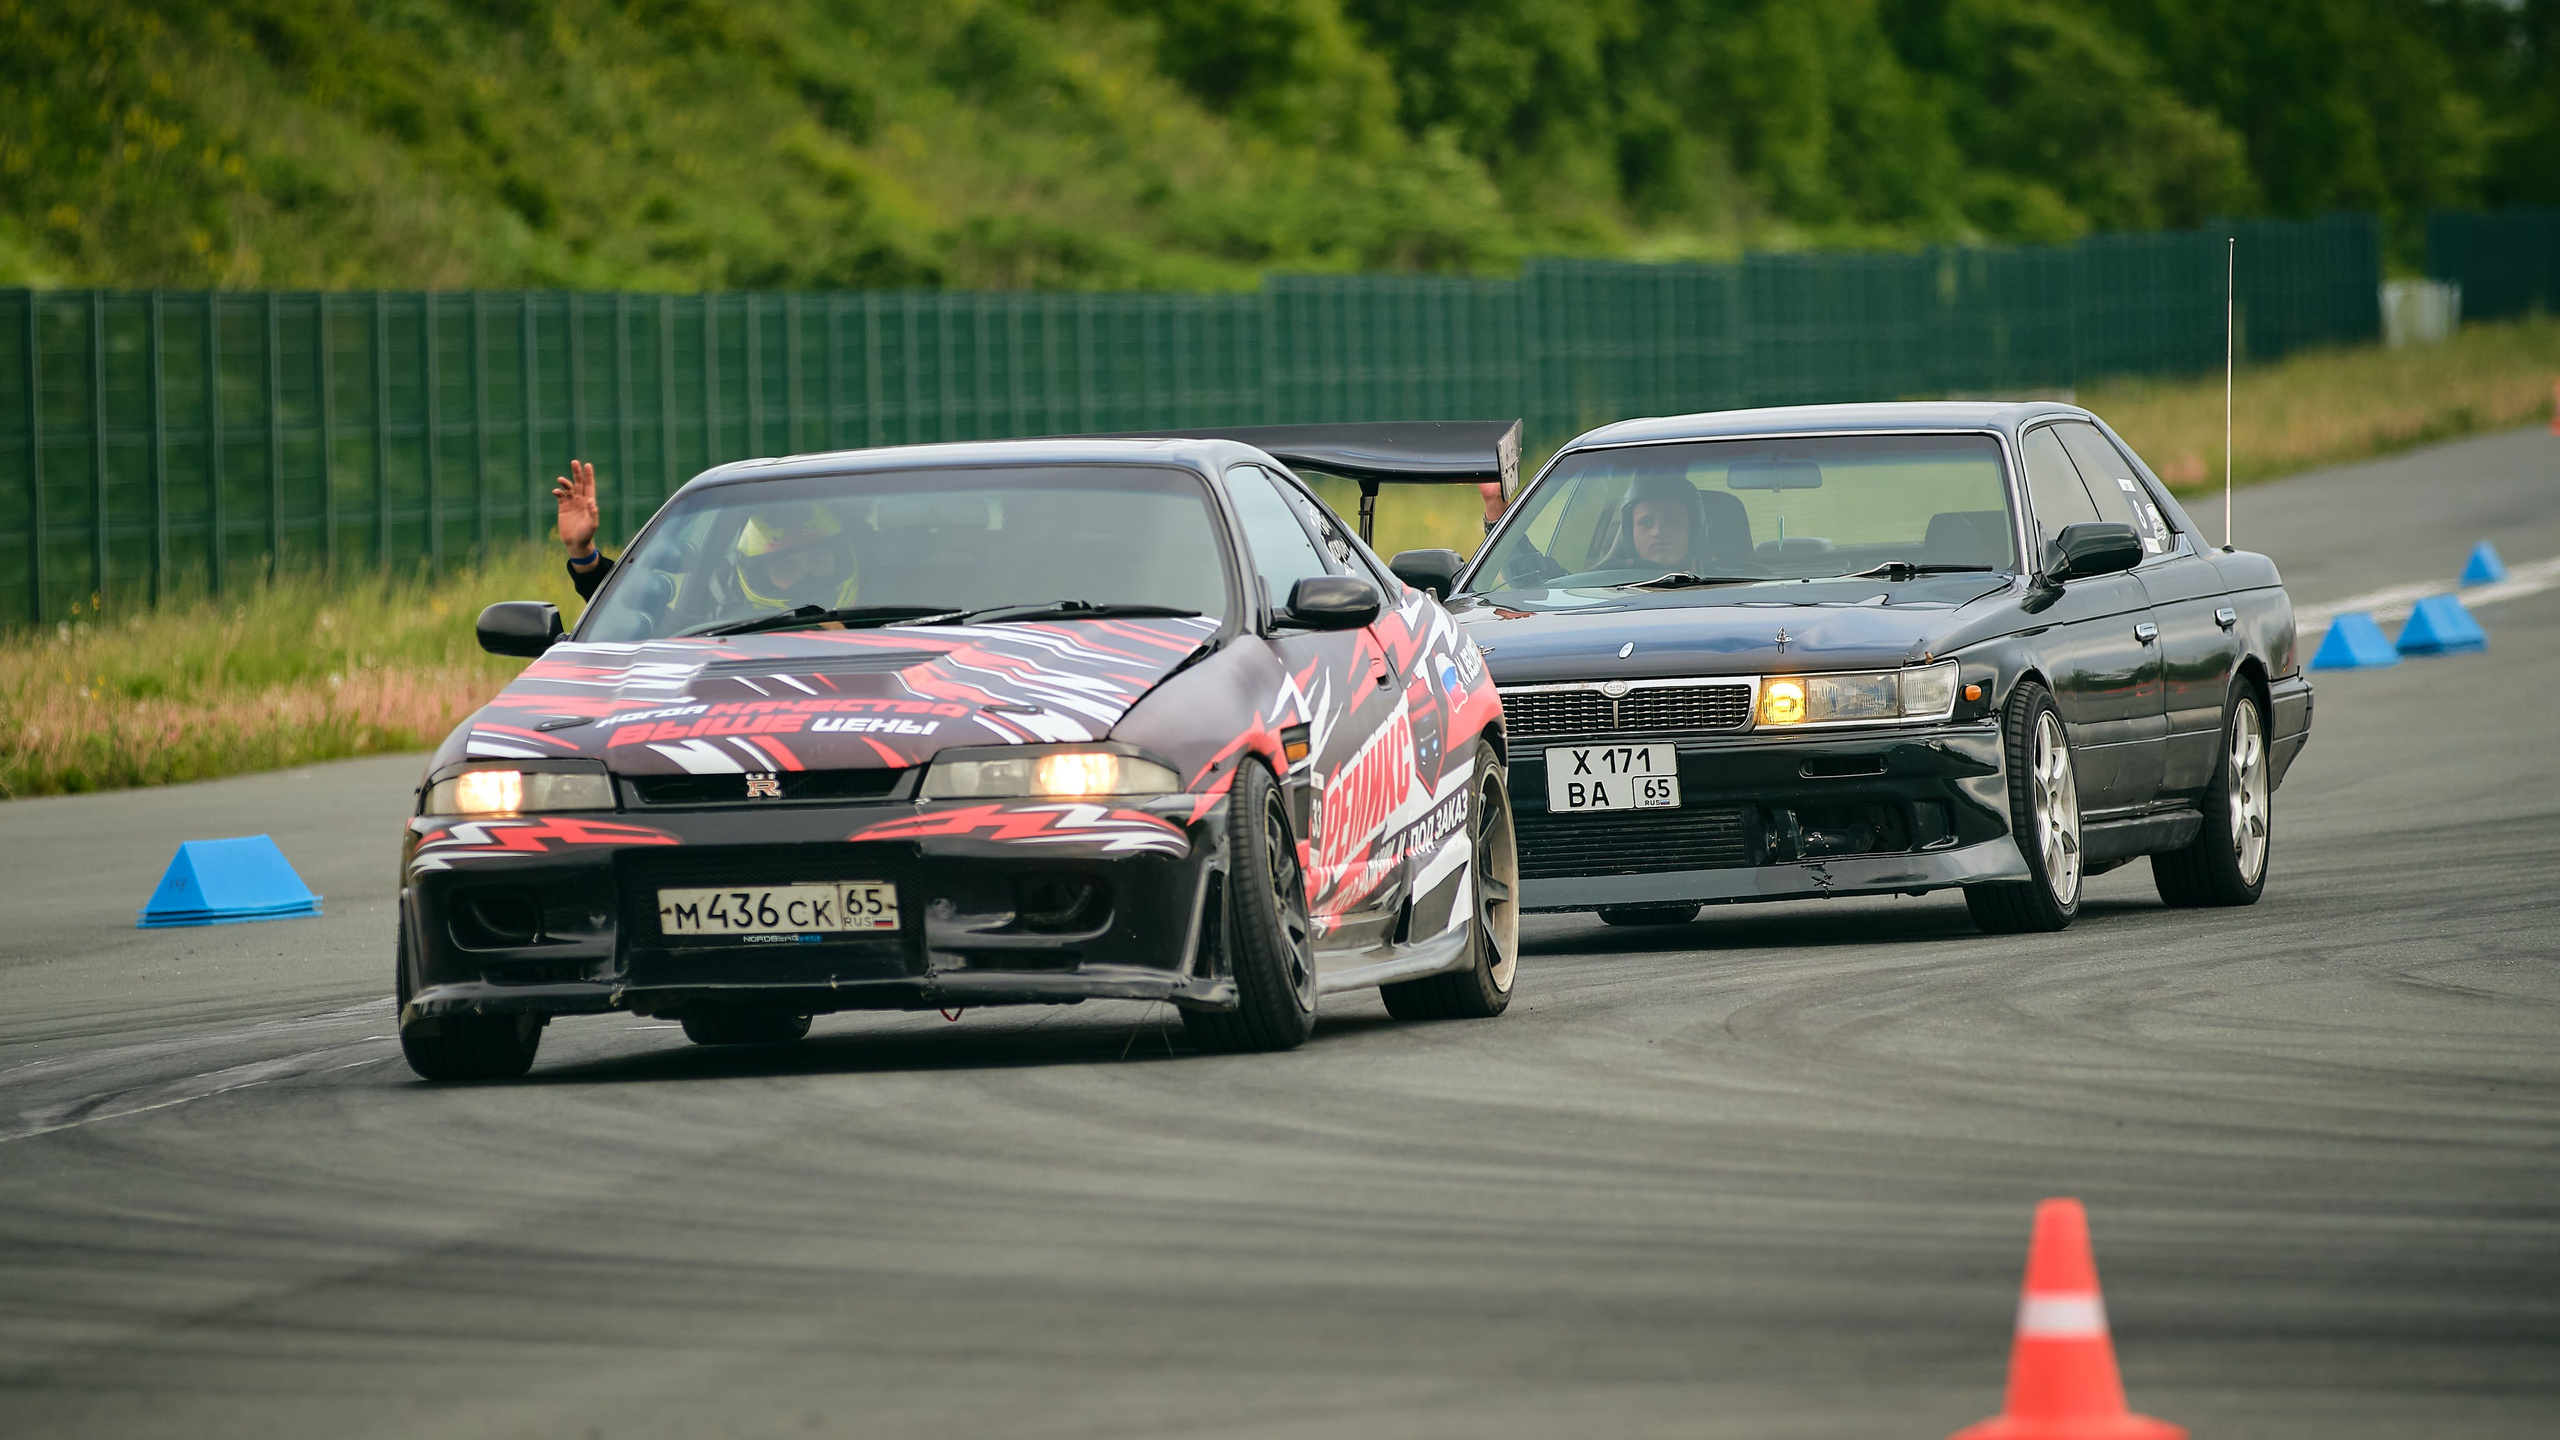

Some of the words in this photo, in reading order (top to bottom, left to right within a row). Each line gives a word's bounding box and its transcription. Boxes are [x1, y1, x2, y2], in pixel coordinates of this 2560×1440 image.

[2132, 499, 2148, 530] 8
[706, 699, 969, 719] КАЧЕСТВО
[606, 713, 812, 749] ВЫШЕ
[810, 717, 941, 736] ЦЕНЫ
[1602, 748, 1651, 774] 171
[1567, 781, 1610, 808] ВА
[1644, 778, 1671, 799] 65
[1311, 798, 1322, 839] 33
[1410, 814, 1435, 856] ПОД
[1435, 788, 1469, 840] ЗАКАЗ
[846, 888, 883, 915] 65
[844, 916, 872, 928] RUS
